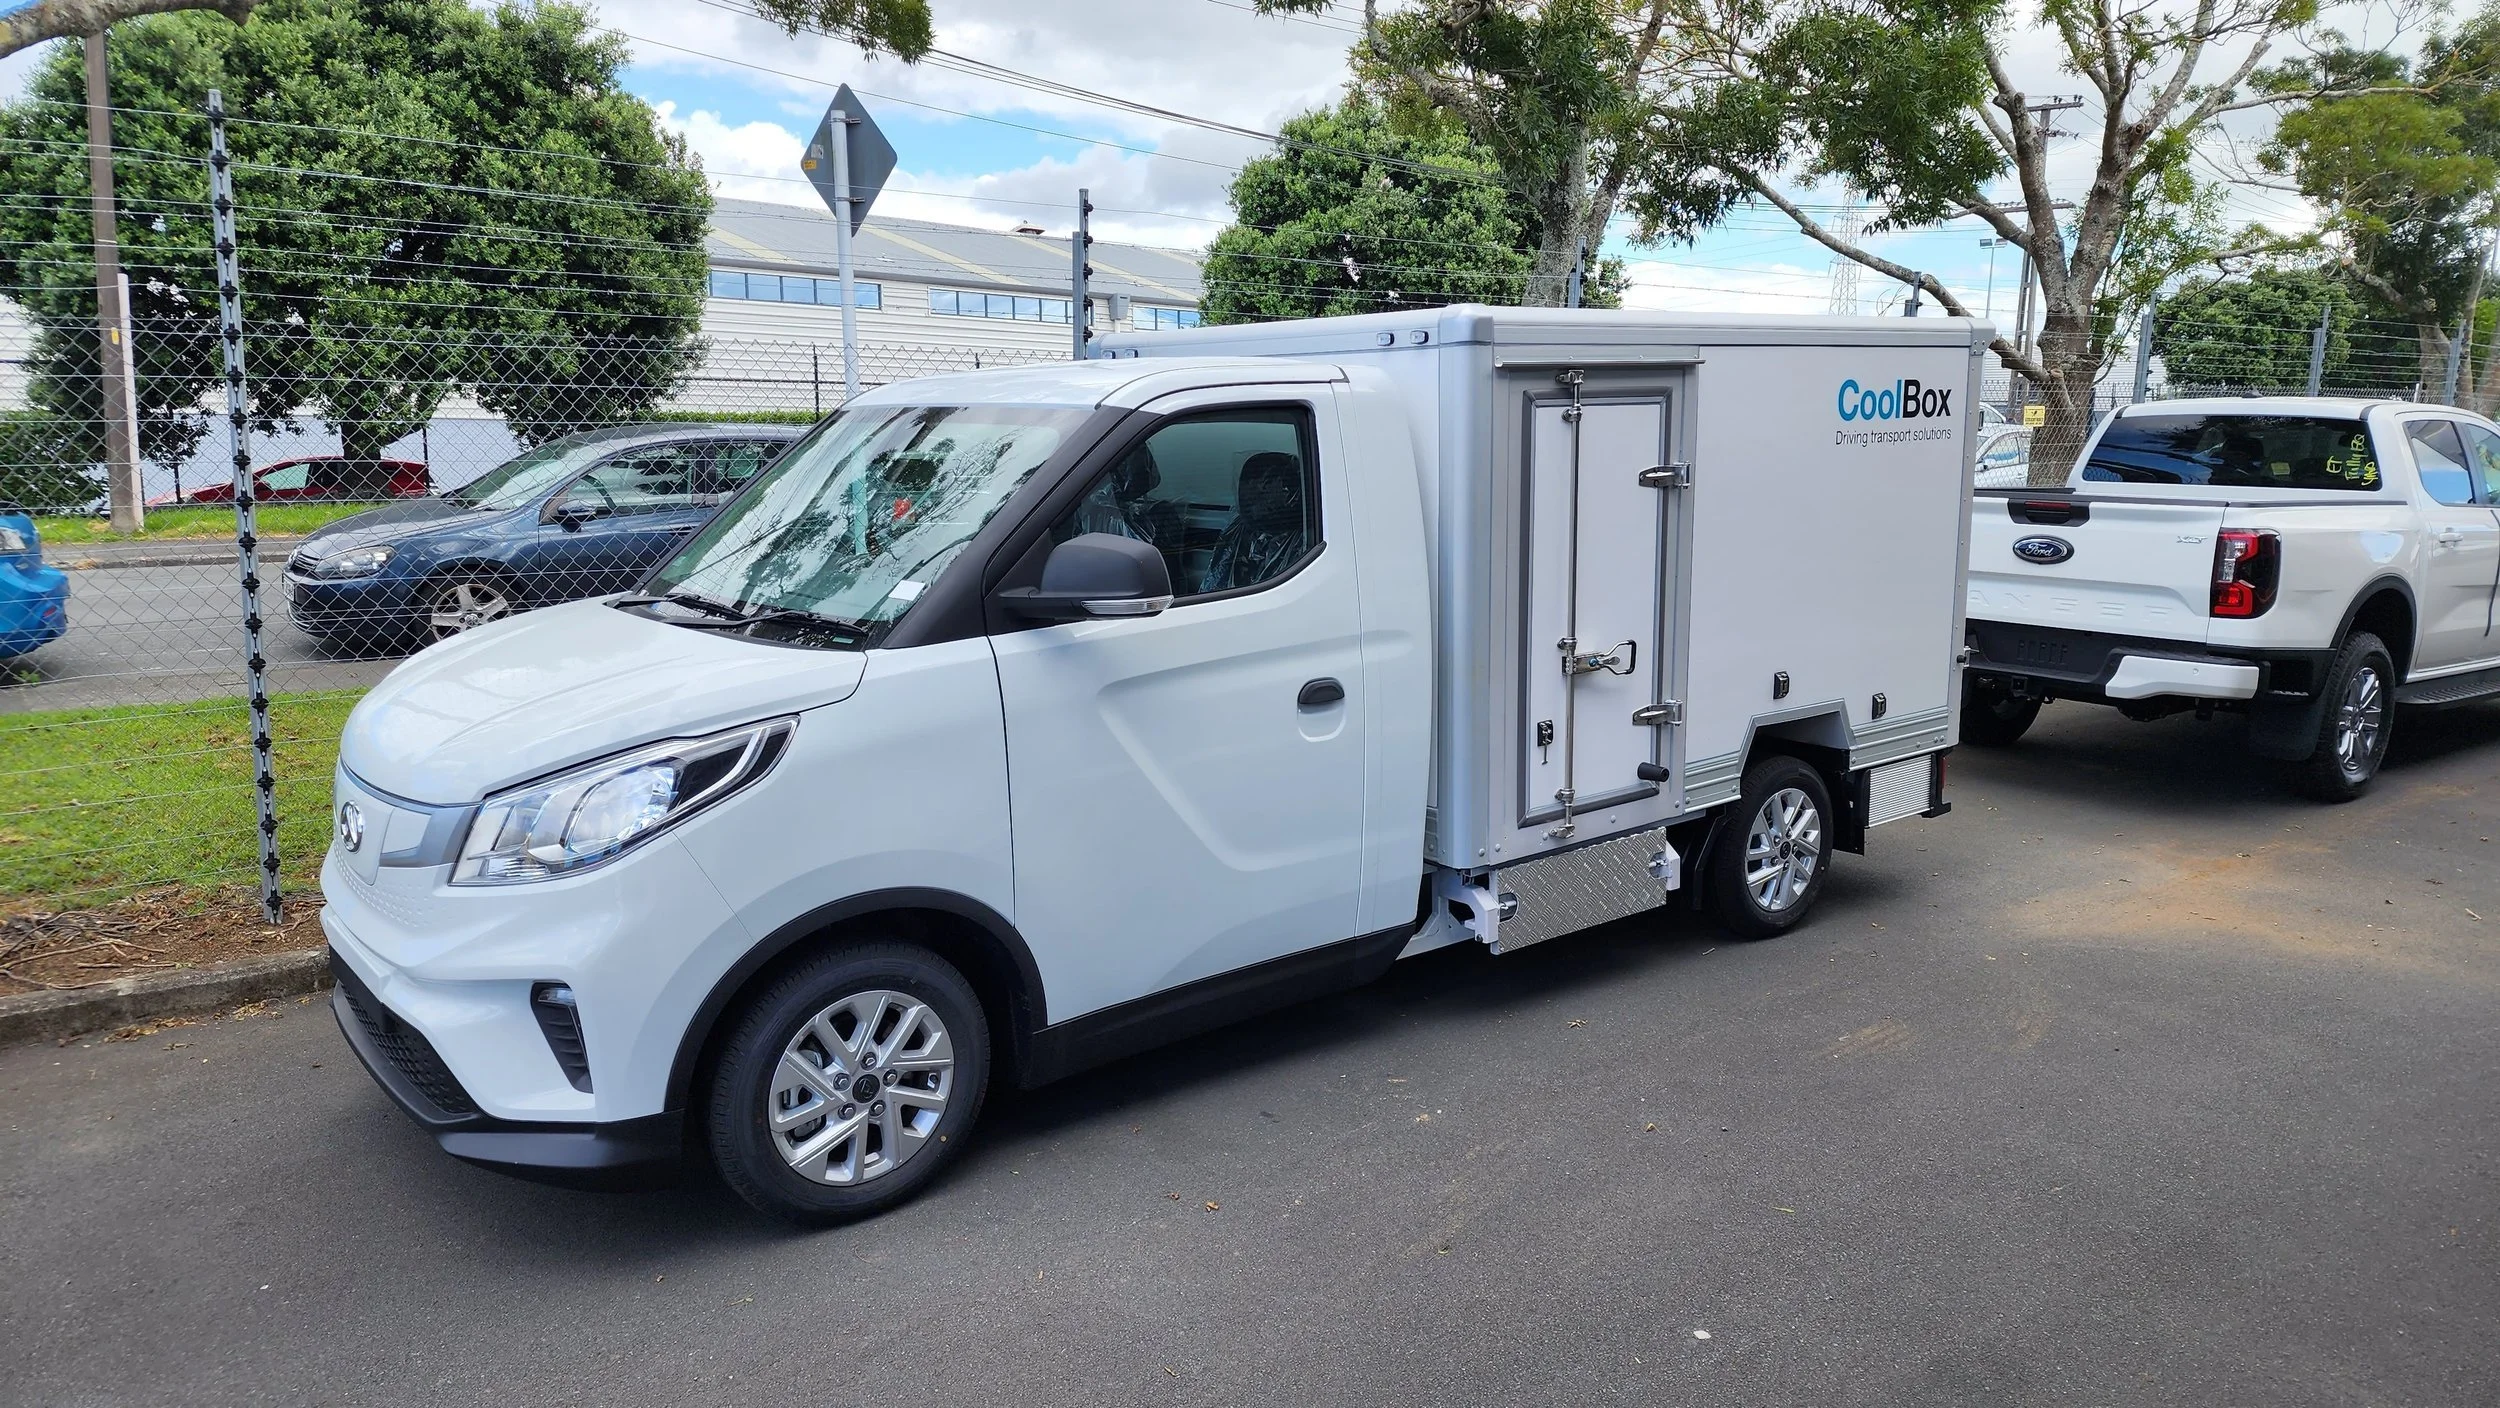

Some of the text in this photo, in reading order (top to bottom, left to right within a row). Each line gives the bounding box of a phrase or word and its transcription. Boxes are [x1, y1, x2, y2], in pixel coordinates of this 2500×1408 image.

[1838, 379, 1952, 421] CoolBox
[1835, 427, 1952, 447] Driving transport solutions
[2025, 542, 2054, 557] Ford
